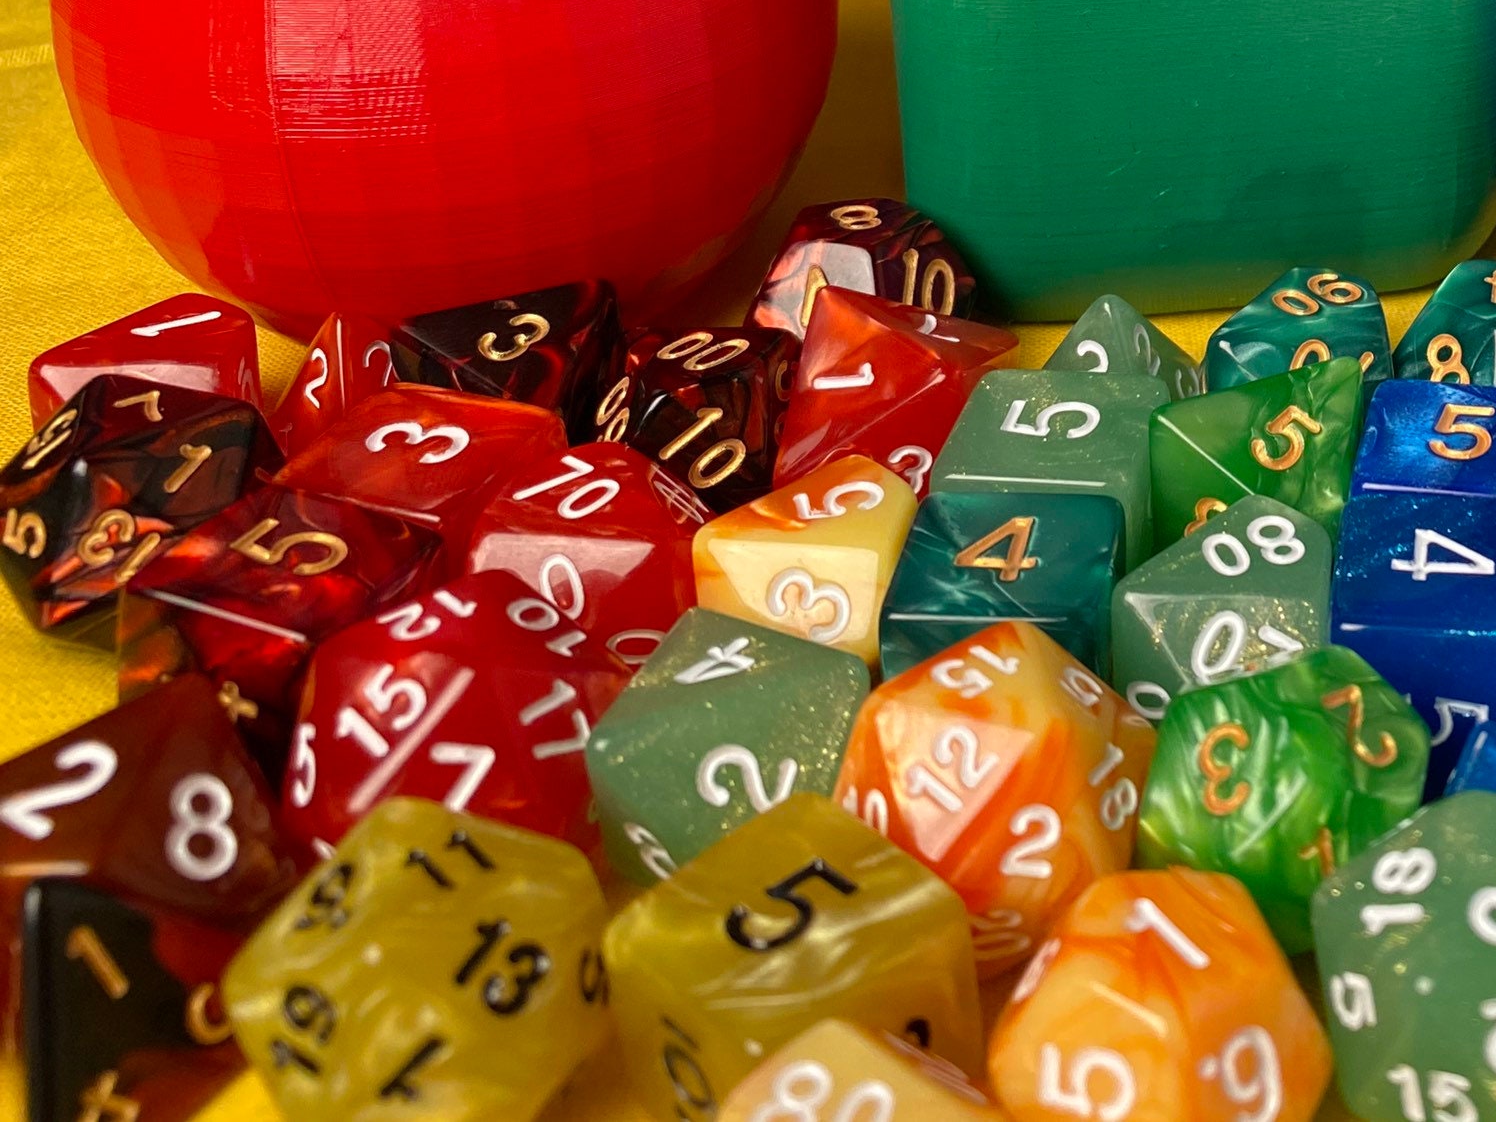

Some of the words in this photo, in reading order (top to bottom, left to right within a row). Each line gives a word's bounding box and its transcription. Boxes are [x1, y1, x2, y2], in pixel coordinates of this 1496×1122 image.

[830, 205, 883, 231] 8
[902, 248, 956, 316] 10
[131, 311, 221, 337] 1
[477, 314, 550, 361] 3
[657, 332, 750, 371] 00
[304, 347, 329, 409] 2
[813, 362, 875, 390] 1
[365, 421, 470, 464] 3
[658, 407, 747, 488] 10
[1000, 399, 1101, 440] 5
[1251, 405, 1323, 472] 5
[1428, 404, 1496, 460] 5
[164, 443, 213, 494] 1
[512, 454, 621, 520] 10
[793, 480, 886, 521] 5
[2, 508, 47, 559] 5
[230, 518, 348, 576] 5
[954, 515, 1040, 582] 4
[1202, 515, 1306, 576] 80
[1390, 528, 1496, 581] 4
[377, 589, 478, 642] 12
[506, 598, 587, 658] 10
[767, 566, 852, 644] 3
[673, 637, 756, 685] 4
[931, 645, 1020, 699] 15
[334, 663, 427, 759] 15
[518, 679, 592, 759] 17
[0, 739, 118, 840] 2
[429, 742, 496, 812] 7
[697, 744, 798, 814] 2
[907, 724, 999, 814] 12
[1089, 742, 1139, 831] 18
[1197, 722, 1250, 816] 3
[163, 772, 239, 882] 8
[405, 828, 496, 889] 11
[1001, 803, 1062, 880] 2
[724, 856, 860, 953] 5
[1358, 846, 1438, 937] 18
[66, 925, 130, 999] 1
[455, 916, 552, 1016] 13
[1125, 896, 1211, 970] 1
[268, 985, 339, 1075] 19
[1037, 1041, 1138, 1122] 5
[1386, 1063, 1479, 1122] 15
